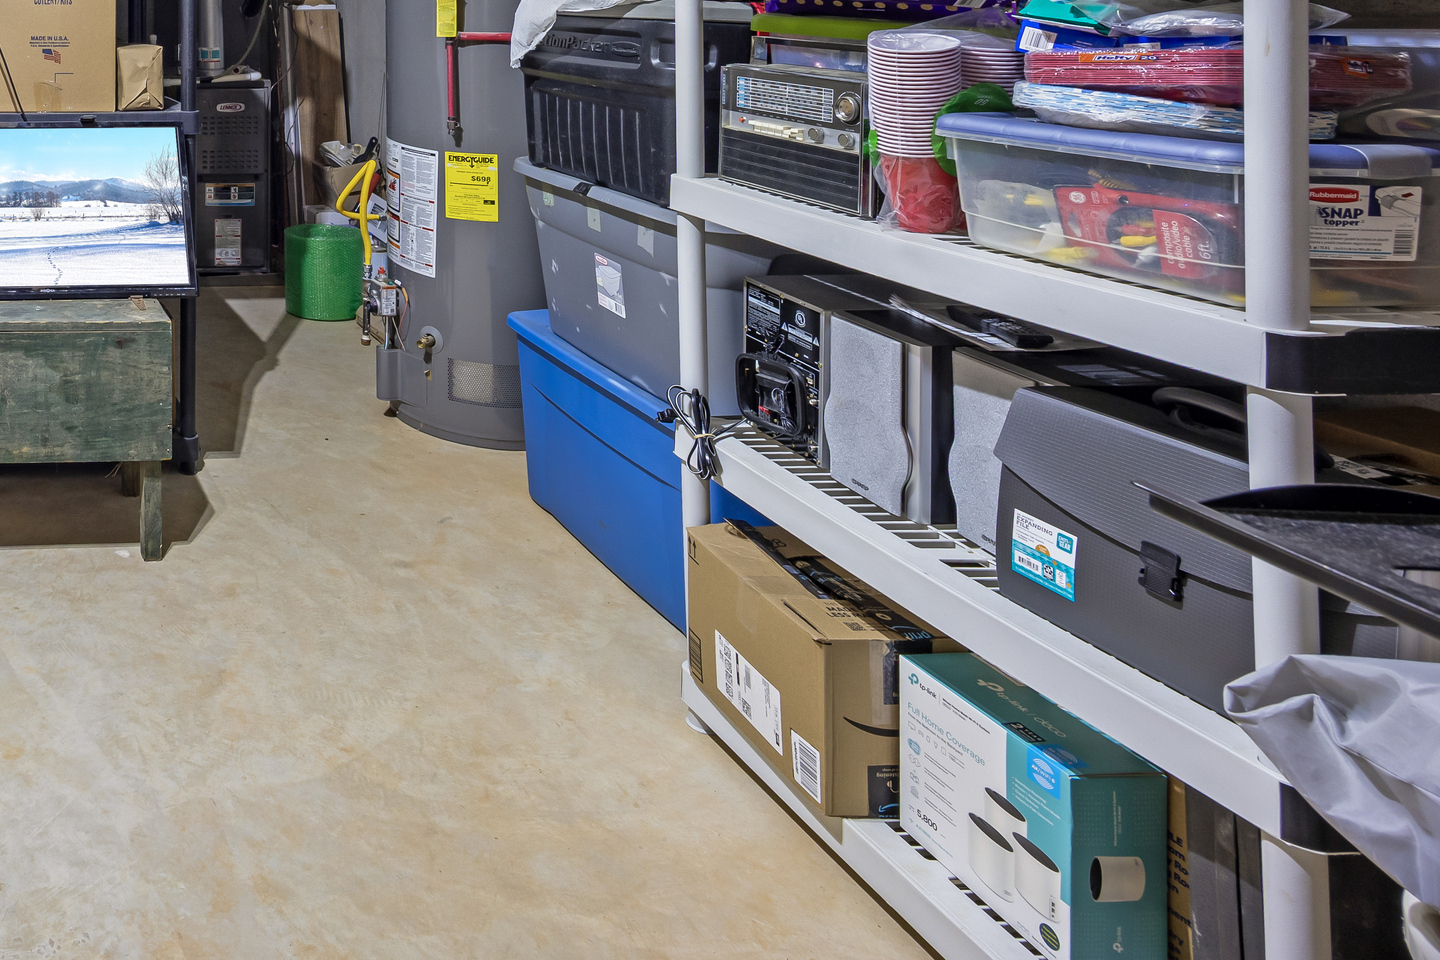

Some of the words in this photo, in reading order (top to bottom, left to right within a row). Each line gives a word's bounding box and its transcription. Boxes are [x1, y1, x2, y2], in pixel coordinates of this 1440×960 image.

[541, 34, 610, 53] tionPacker
[448, 155, 494, 165] ENERGYGUIDE
[1309, 191, 1357, 199] Rubbermaid
[1319, 206, 1364, 219] SNAP
[1324, 219, 1360, 227] topper
[1182, 235, 1194, 258] cable
[1016, 515, 1053, 536] EXPANDING
[1016, 520, 1030, 531] FILE
[920, 683, 937, 699] tp-link
[997, 692, 1028, 712] tp-link
[907, 702, 920, 716] Full
[921, 713, 944, 735] Home
[946, 731, 986, 766] Coverage
